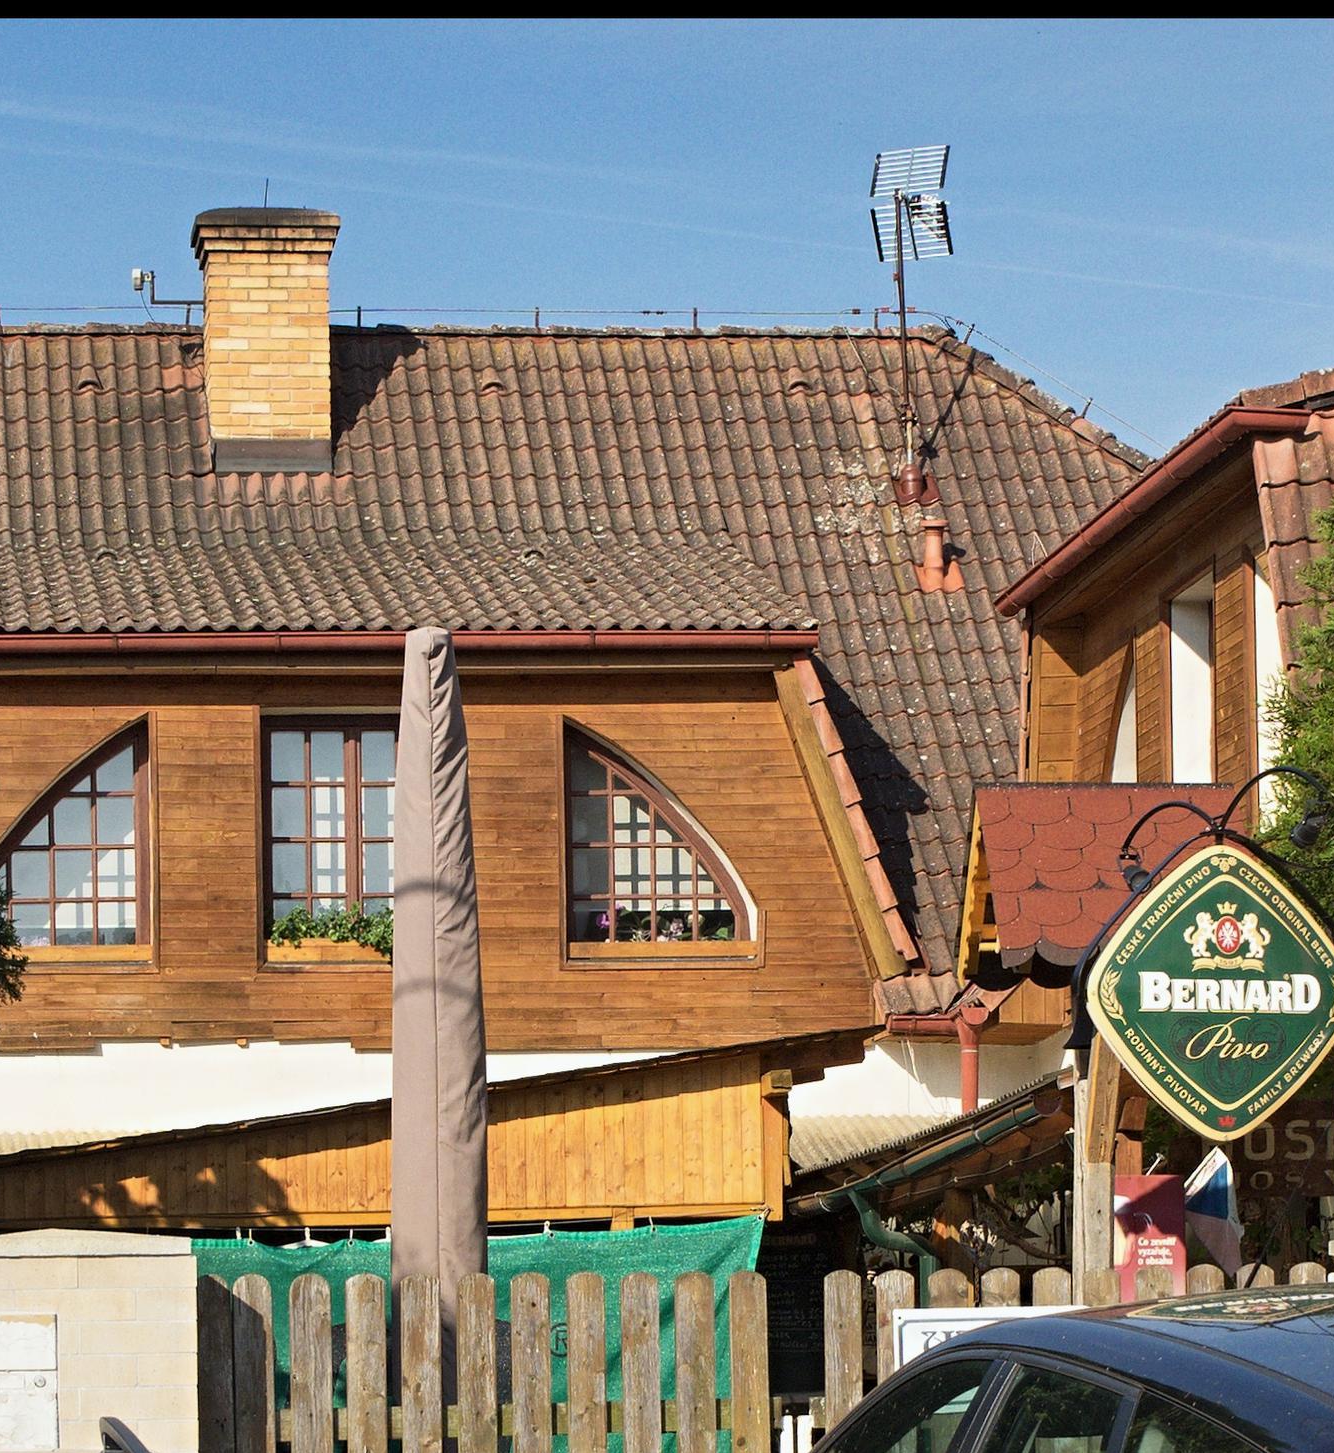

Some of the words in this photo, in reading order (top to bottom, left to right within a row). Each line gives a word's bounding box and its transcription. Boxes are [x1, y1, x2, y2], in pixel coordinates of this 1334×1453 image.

[1116, 929, 1146, 965] ČESKÉ
[1142, 884, 1187, 931] TRADIČNÍ
[1186, 865, 1211, 890] PIVO
[1238, 866, 1271, 898] CZECH
[1270, 894, 1312, 942] ORIGINAL
[1310, 939, 1333, 969] BEER
[1138, 971, 1322, 1014] BERNARD
[1124, 1028, 1168, 1075] RODINNÝ
[1163, 1073, 1209, 1116] PIVOVAR
[1185, 1016, 1270, 1061] Pivo
[1247, 1081, 1284, 1116] FAMILY
[1283, 1030, 1328, 1084] BREWERY
